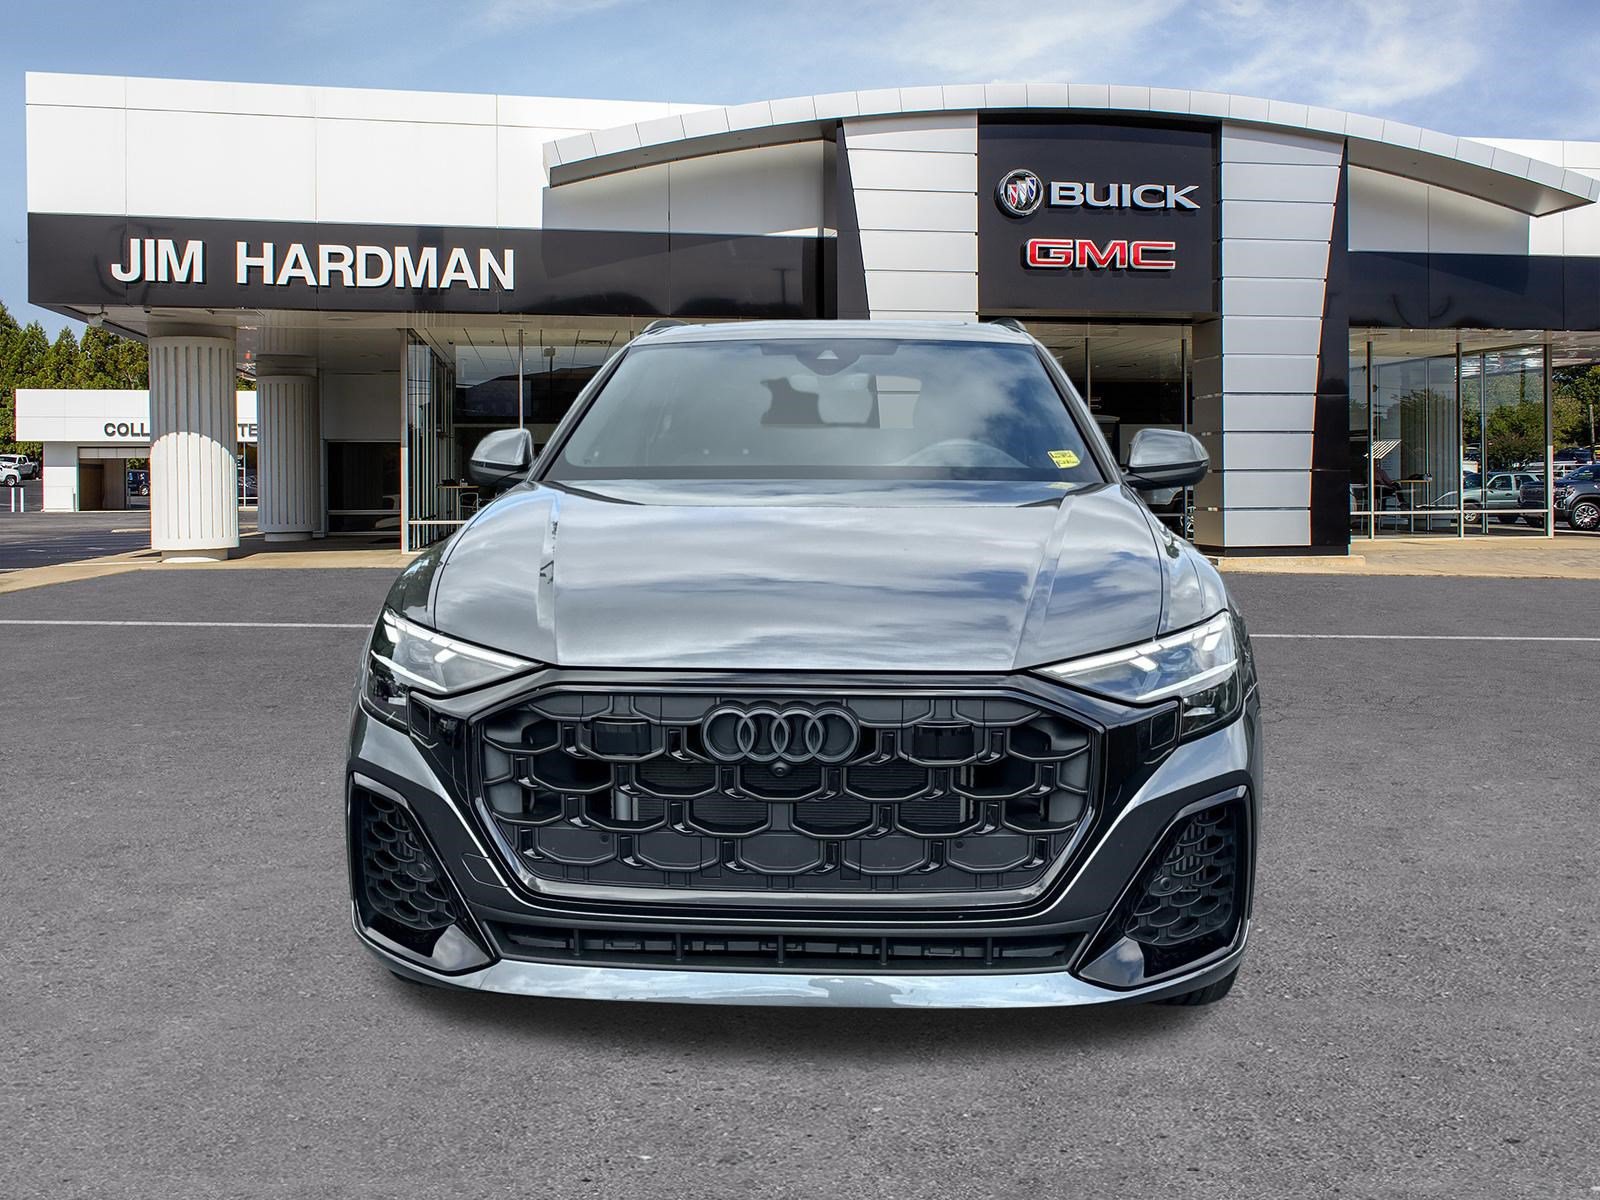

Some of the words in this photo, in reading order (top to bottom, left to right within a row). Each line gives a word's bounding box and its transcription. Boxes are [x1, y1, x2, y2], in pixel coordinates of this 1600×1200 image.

[1050, 181, 1200, 209] BUICK
[111, 238, 204, 283] JIM
[236, 241, 514, 290] HARDMAN
[1026, 238, 1176, 270] GMC
[104, 422, 150, 437] COLL
[238, 422, 258, 437] TE
